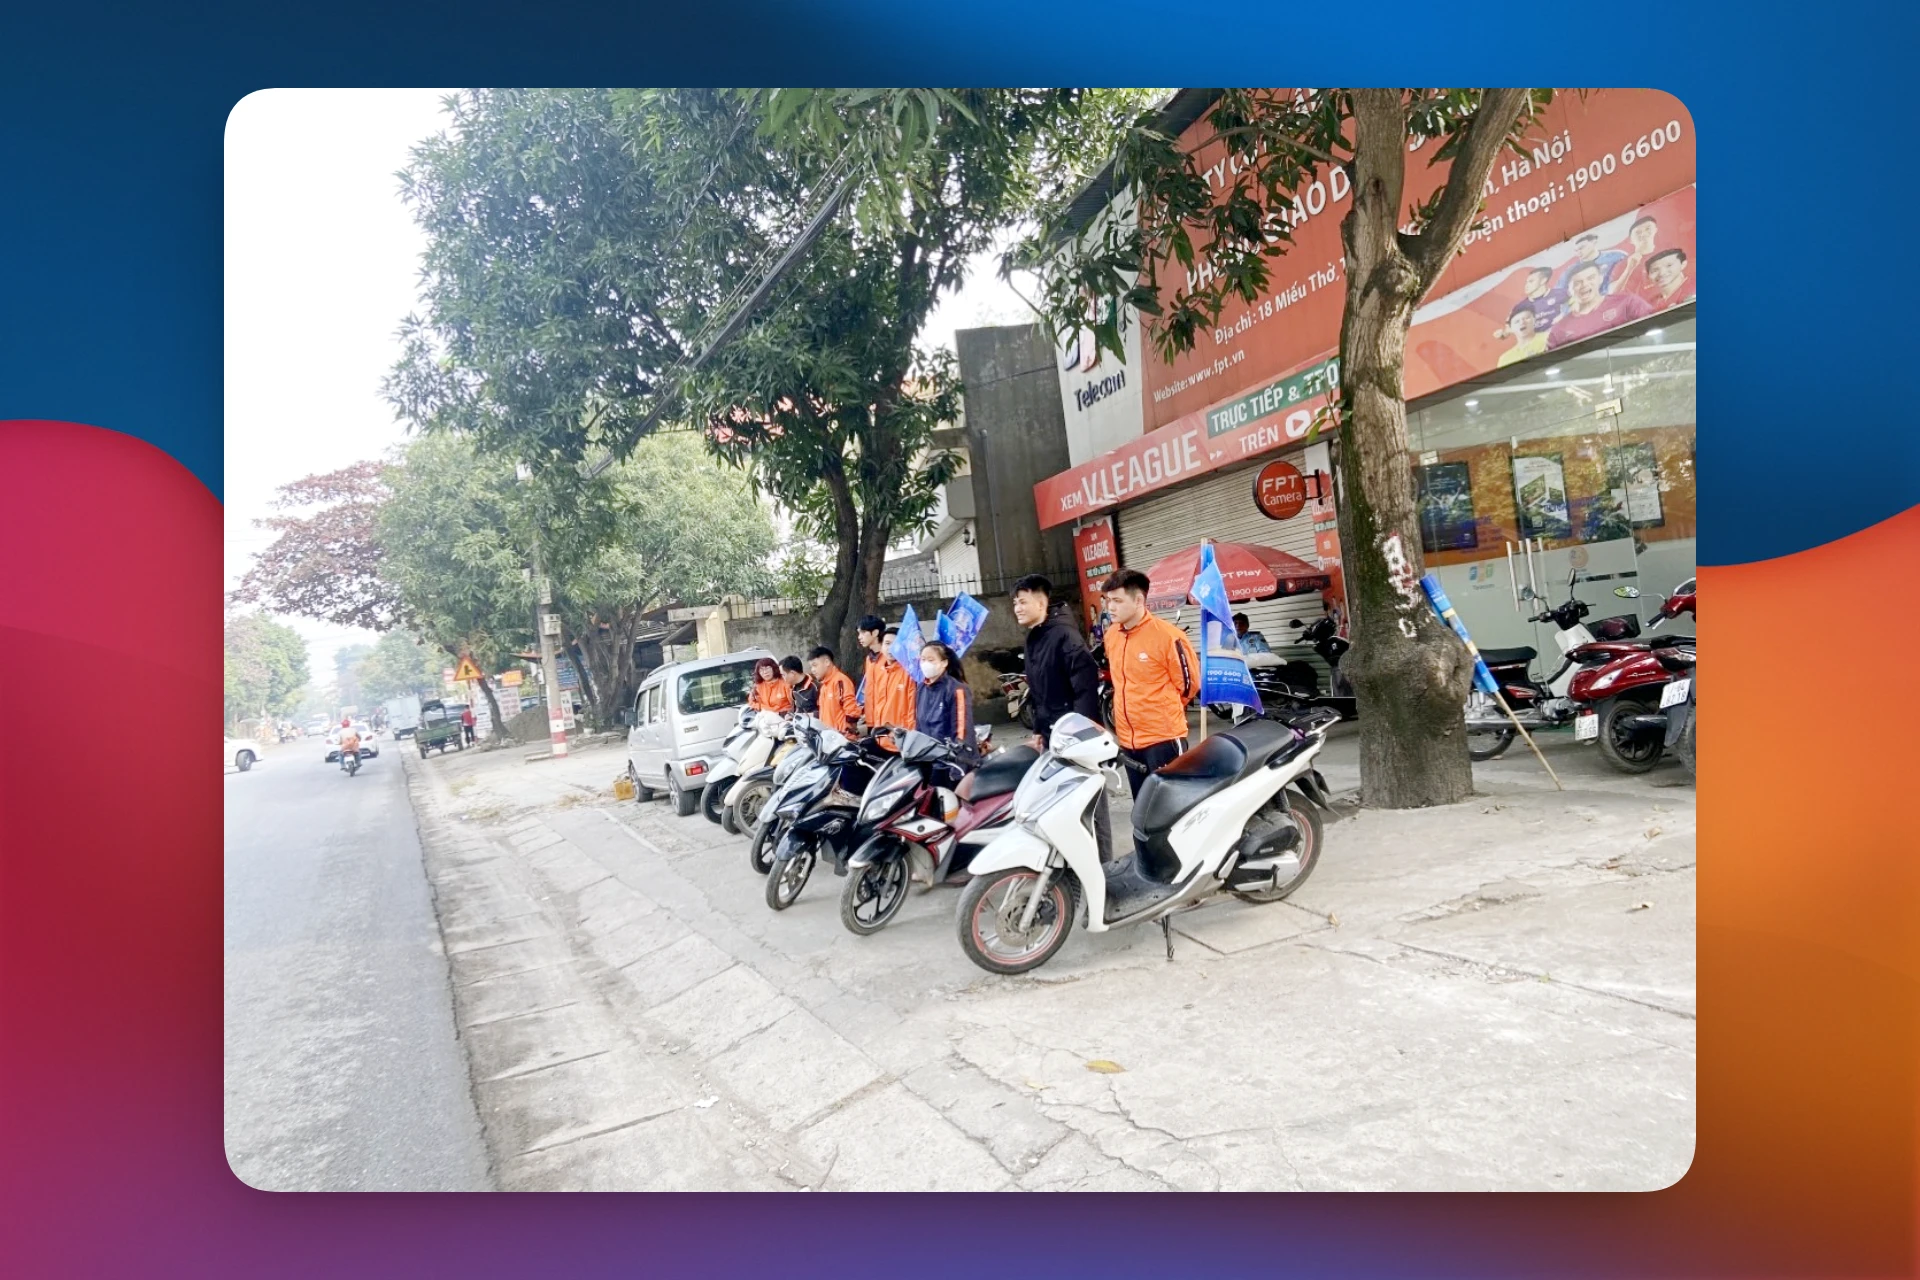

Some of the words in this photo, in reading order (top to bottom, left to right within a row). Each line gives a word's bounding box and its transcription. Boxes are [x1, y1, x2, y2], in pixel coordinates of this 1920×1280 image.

[1502, 155, 1532, 187] Hà
[1533, 129, 1572, 169] Nội
[1566, 153, 1616, 193] 1900
[1621, 120, 1681, 166] 6600
[1215, 324, 1234, 345] Địa
[1258, 300, 1273, 321] 18
[1275, 281, 1307, 312] Miếu
[1308, 261, 1340, 292] Thờ,
[1073, 369, 1126, 412] Telecom
[1211, 402, 1248, 433] TRỰC
[1250, 384, 1284, 417] TIẾP
[1288, 386, 1300, 401] &
[1239, 424, 1279, 454] TRÊN
[1262, 474, 1299, 494] FPT
[1263, 491, 1303, 506] Camera
[1060, 489, 1083, 511] XEM
[1236, 568, 1262, 578] Play
[1231, 588, 1251, 596] 1900
[1253, 585, 1275, 593] 6600
